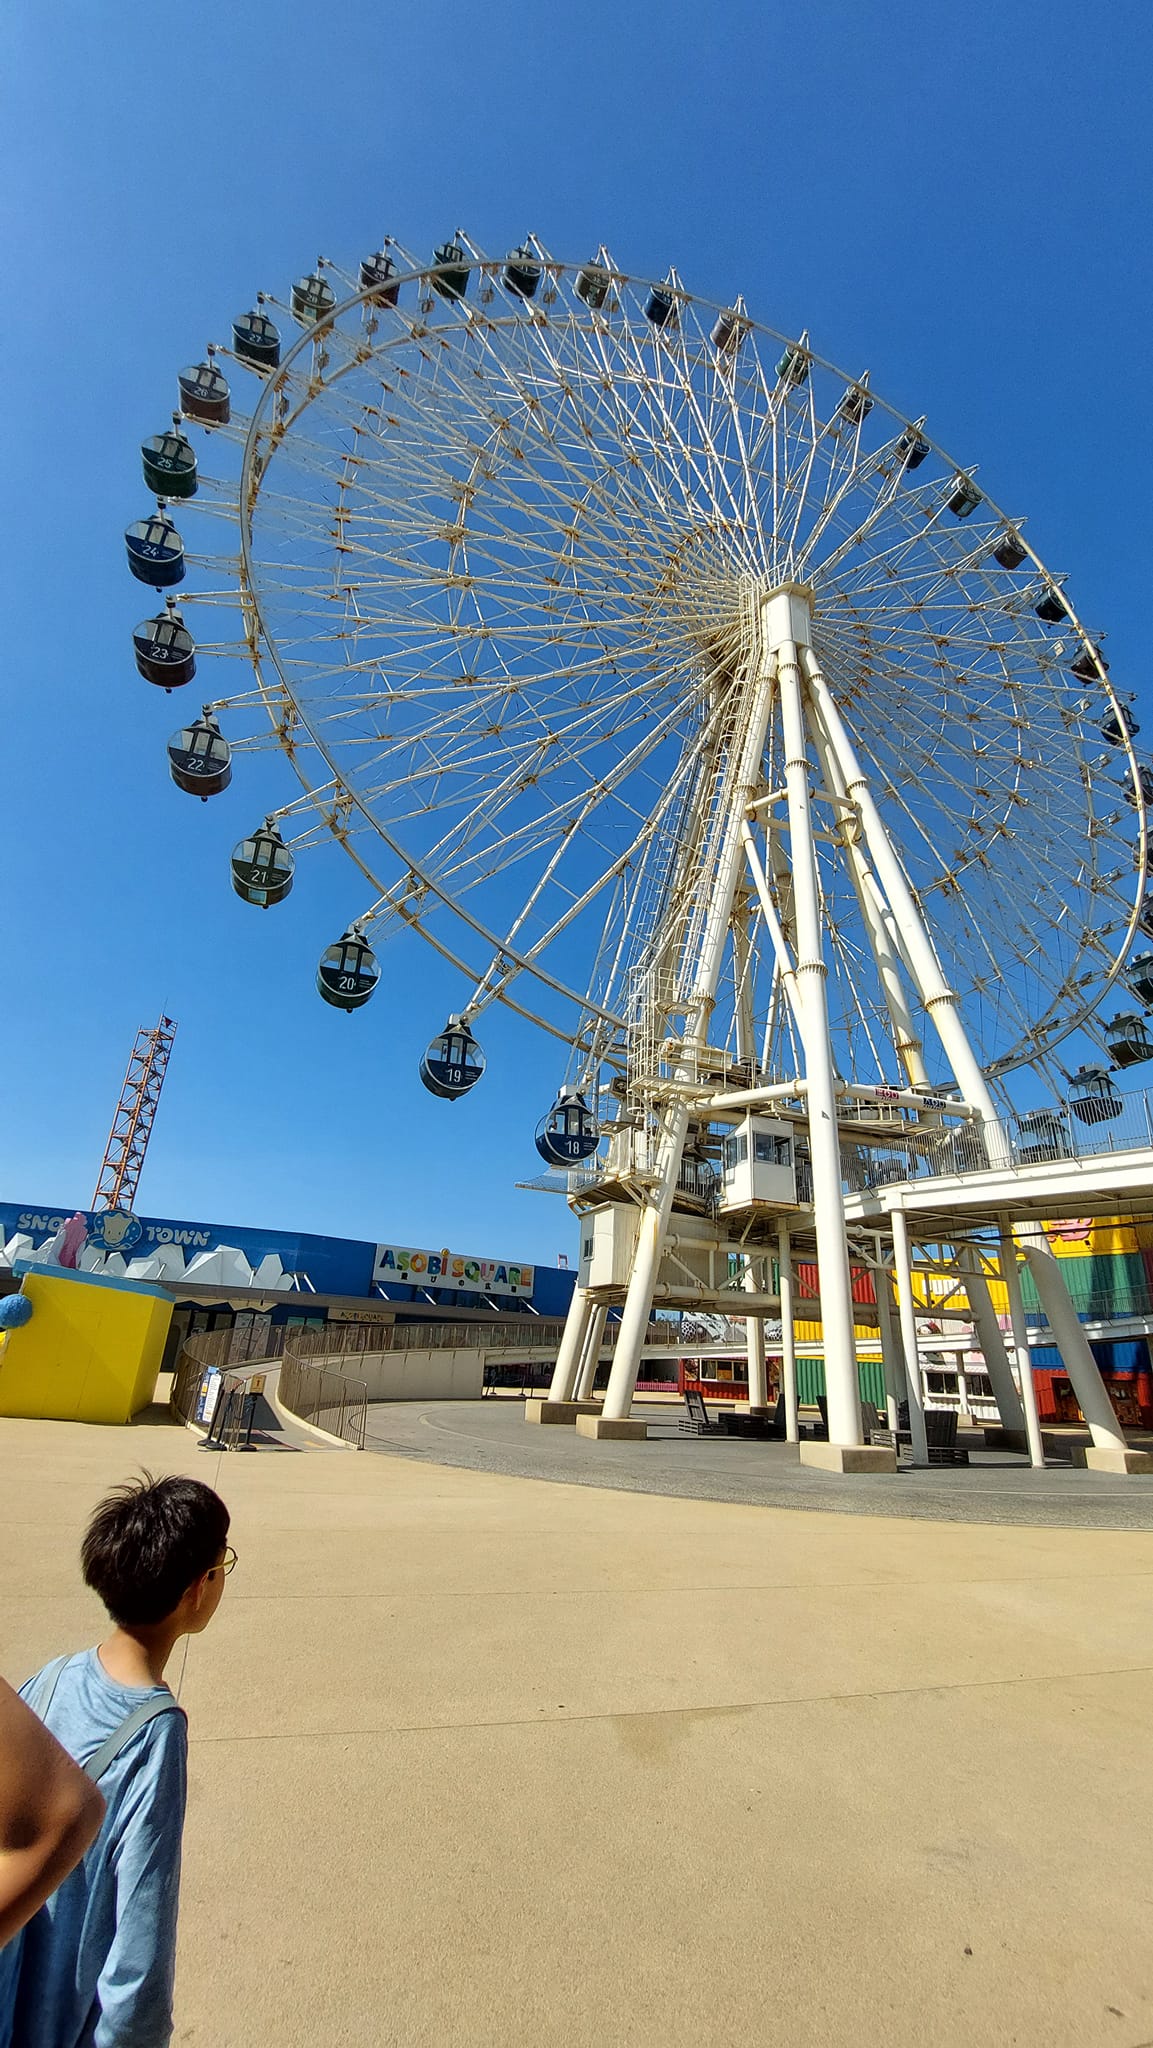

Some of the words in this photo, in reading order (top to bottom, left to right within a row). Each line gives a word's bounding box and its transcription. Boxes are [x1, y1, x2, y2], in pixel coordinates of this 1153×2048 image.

[194, 386, 208, 397] 26
[158, 457, 173, 469] 25
[142, 545, 158, 557] 24
[151, 646, 169, 659] 23
[187, 758, 204, 771] 22
[251, 870, 267, 883] 21
[338, 976, 355, 990] 20
[446, 1068, 461, 1083] 19
[566, 1140, 580, 1155] 18
[17, 1213, 64, 1232] SNO
[146, 1226, 211, 1247] TOWN
[451, 1258, 533, 1287] SQUARE
